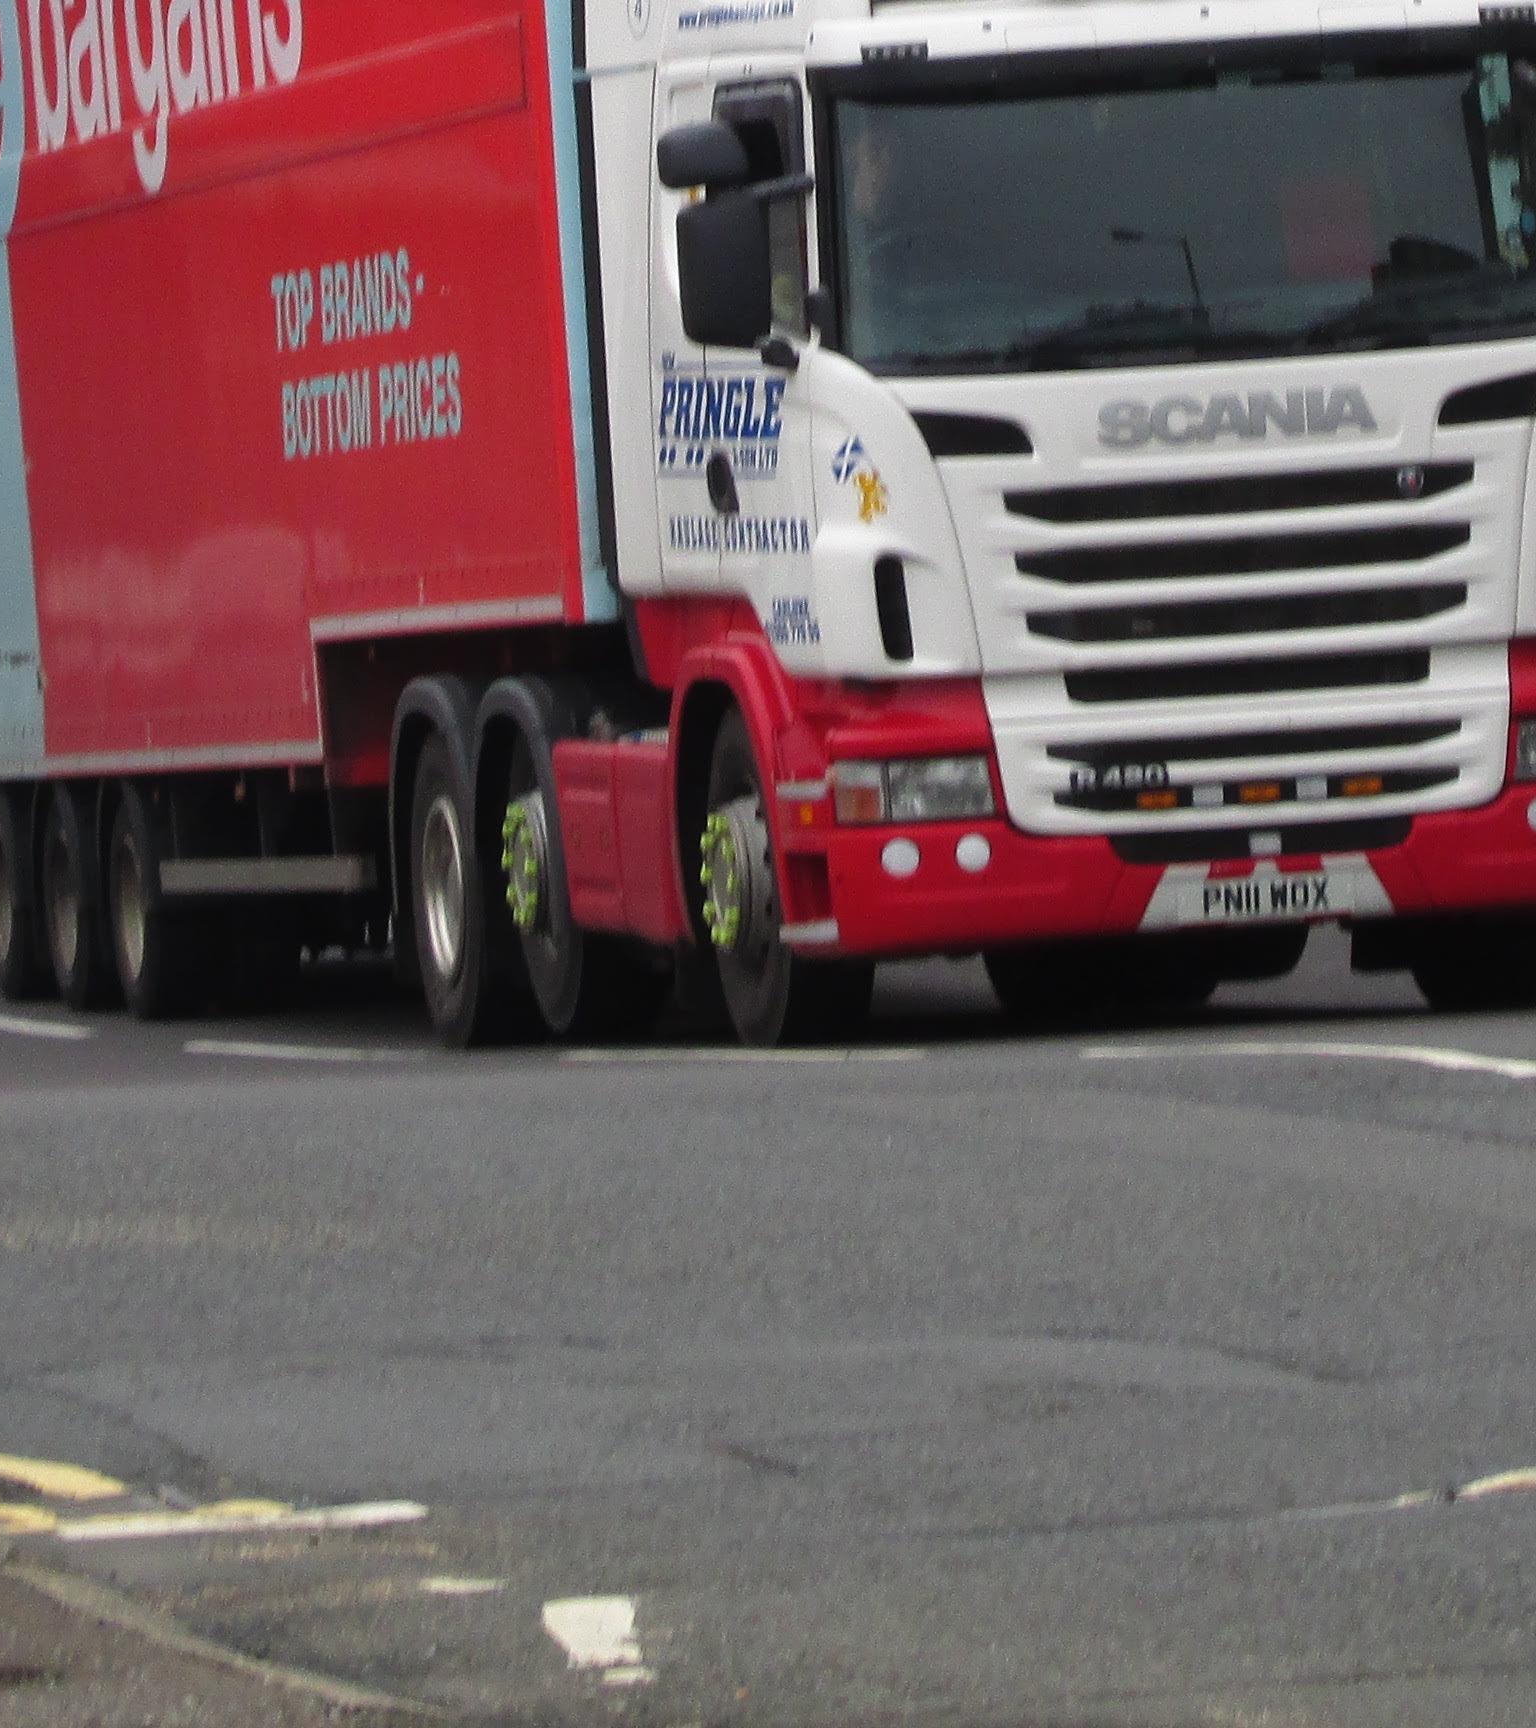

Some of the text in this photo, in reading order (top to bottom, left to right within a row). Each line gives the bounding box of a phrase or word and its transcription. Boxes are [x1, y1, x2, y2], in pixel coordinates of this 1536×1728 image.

[271, 268, 313, 353] TOP
[320, 246, 412, 346] BRANDS
[282, 351, 462, 461] BOTTOM PRICES
[659, 377, 786, 439] PRINGLE
[1098, 381, 1379, 449] SCANIA
[669, 514, 810, 553] HAULAGE CONTRACTOR
[1270, 877, 1329, 911] WOX
